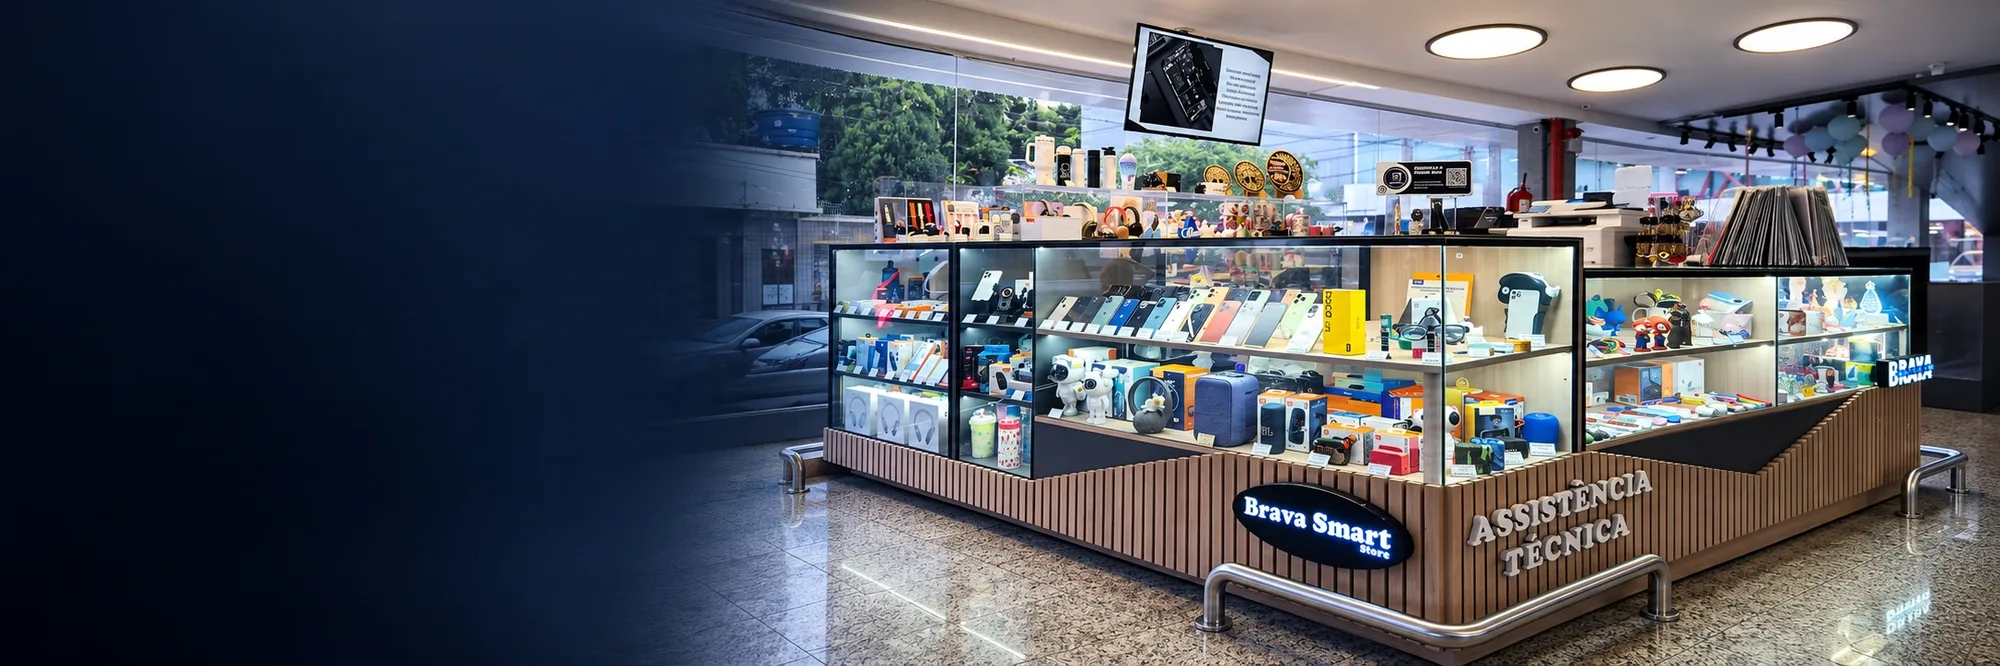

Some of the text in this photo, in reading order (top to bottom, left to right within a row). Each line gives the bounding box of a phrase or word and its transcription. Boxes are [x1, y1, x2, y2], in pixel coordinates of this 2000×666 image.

[1261, 426, 1274, 437] BL
[1243, 495, 1392, 550] Brava Smart
[1466, 469, 1653, 547] ASSISTÊNCIA
[1359, 543, 1391, 560] Store
[1499, 513, 1630, 578] TÉCNICA
